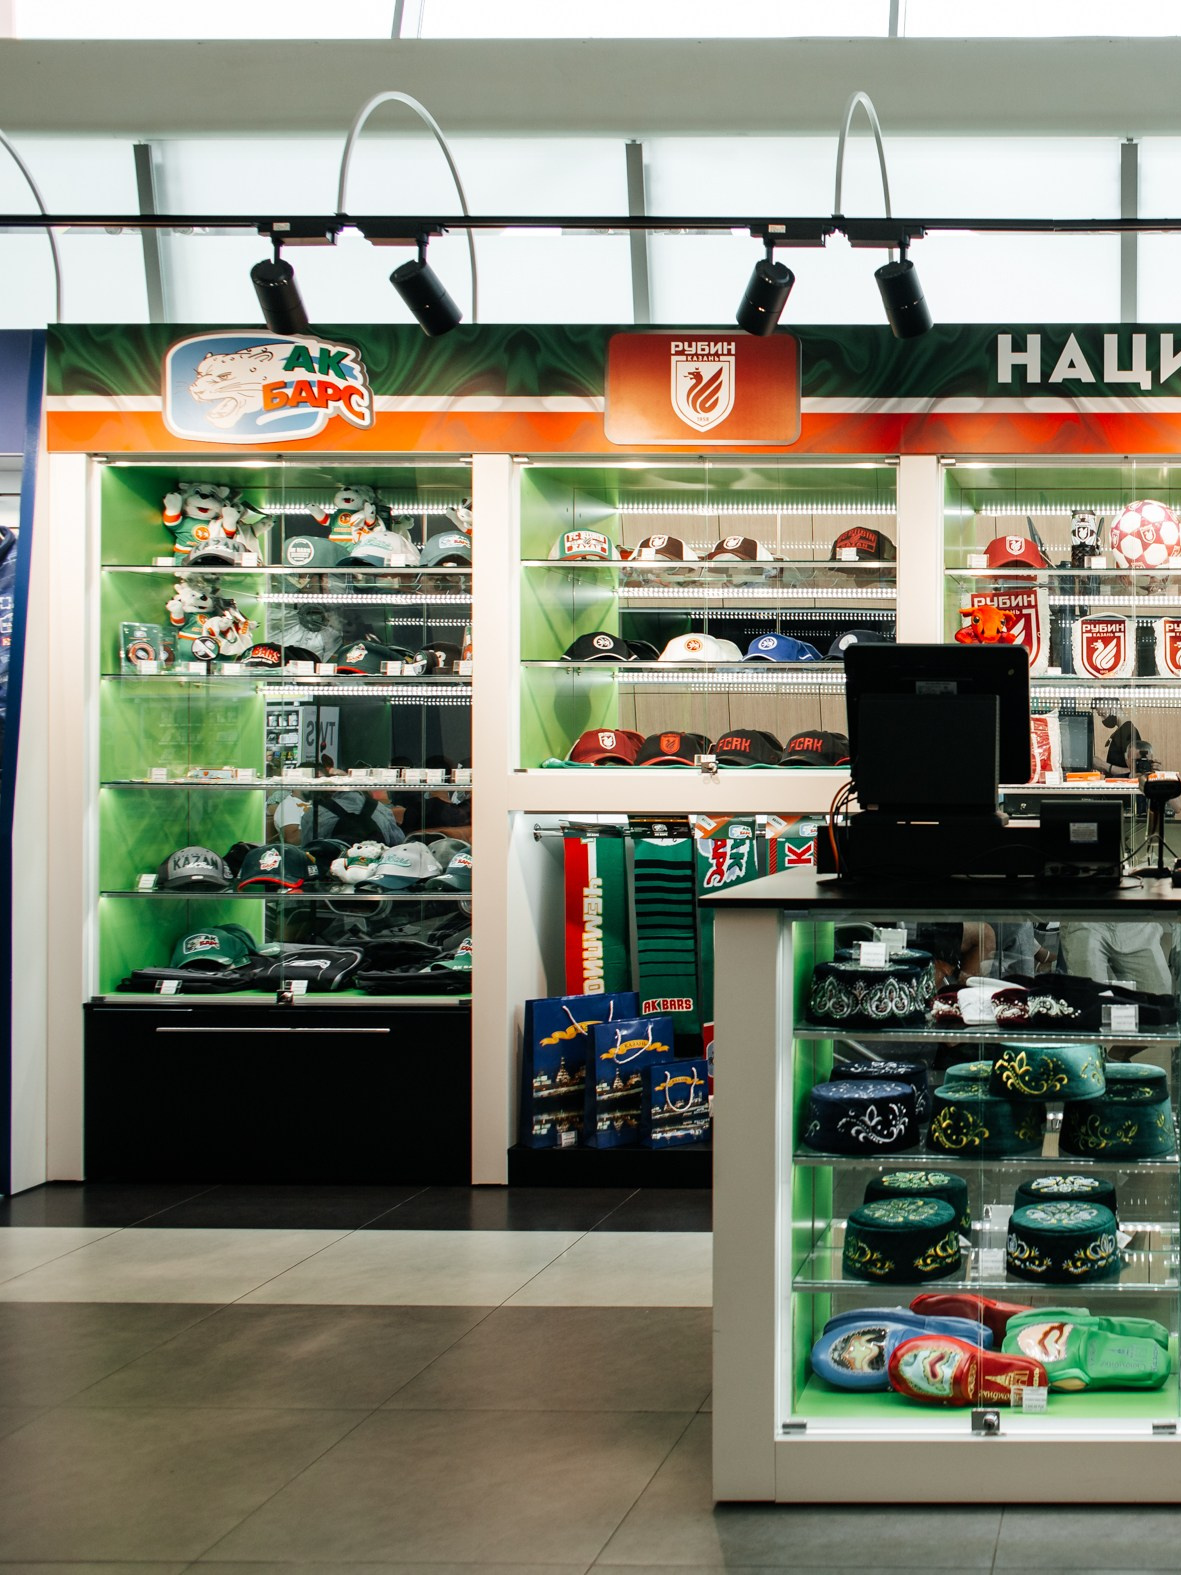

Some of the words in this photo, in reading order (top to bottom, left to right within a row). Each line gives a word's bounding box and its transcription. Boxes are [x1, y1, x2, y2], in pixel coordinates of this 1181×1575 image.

[671, 342, 735, 354] РУБИН
[283, 345, 348, 381] АК
[262, 379, 365, 421] БАРС
[973, 594, 1035, 607] РУБИН
[1082, 623, 1124, 632] РУБИН
[716, 737, 751, 752] FCRK
[788, 737, 824, 753] FCRK
[707, 839, 727, 885] АРС
[582, 878, 605, 995] ЧЕМПИО
[643, 999, 660, 1014] AK
[661, 998, 693, 1011] BARS
